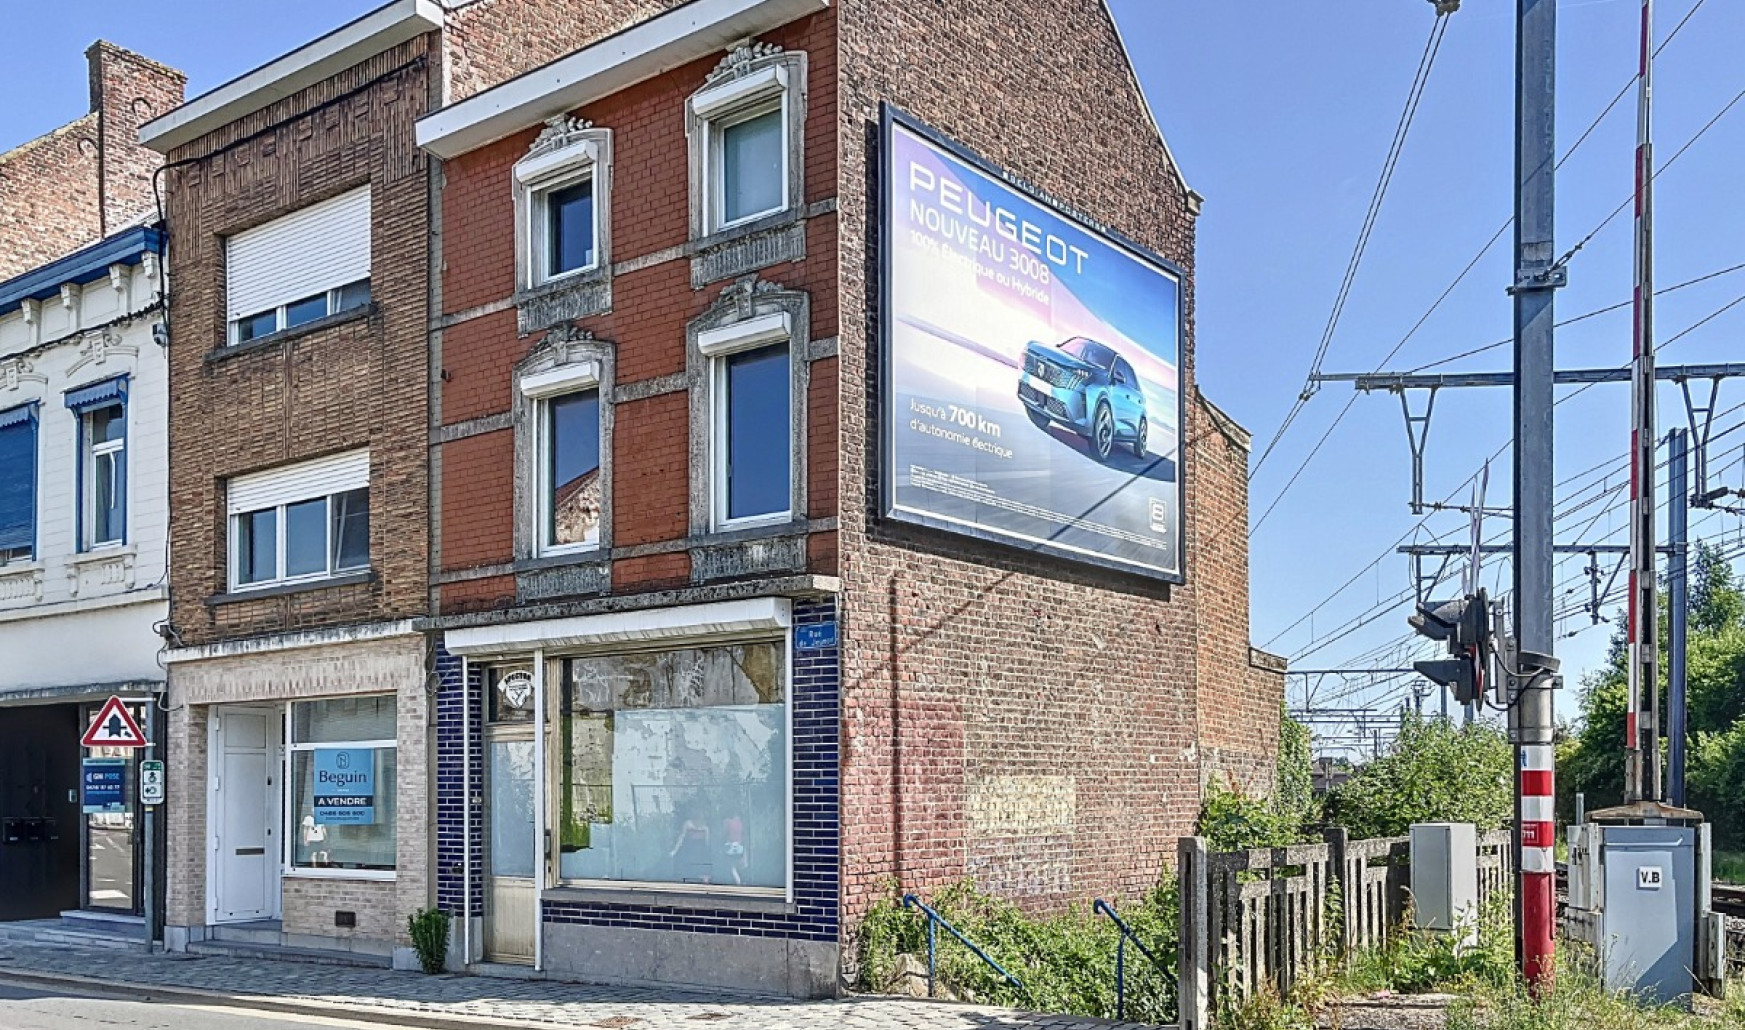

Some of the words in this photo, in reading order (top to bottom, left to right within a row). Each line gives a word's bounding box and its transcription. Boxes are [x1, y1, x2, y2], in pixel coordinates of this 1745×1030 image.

[909, 160, 1088, 274] PEUGEOT
[910, 199, 1004, 263] NOUVEAU
[1010, 248, 1050, 285] 3008
[909, 230, 939, 256] 100%
[996, 271, 1010, 287] ou
[1011, 276, 1050, 305] Hybride
[909, 397, 946, 421] Jusqu'à
[948, 404, 976, 429] 700
[978, 414, 1001, 438] km
[909, 418, 971, 446] d'autonomie
[319, 770, 367, 787] Beguin
[318, 797, 325, 805] A
[327, 797, 366, 805] VENDRE
[1640, 871, 1661, 884] V.B
